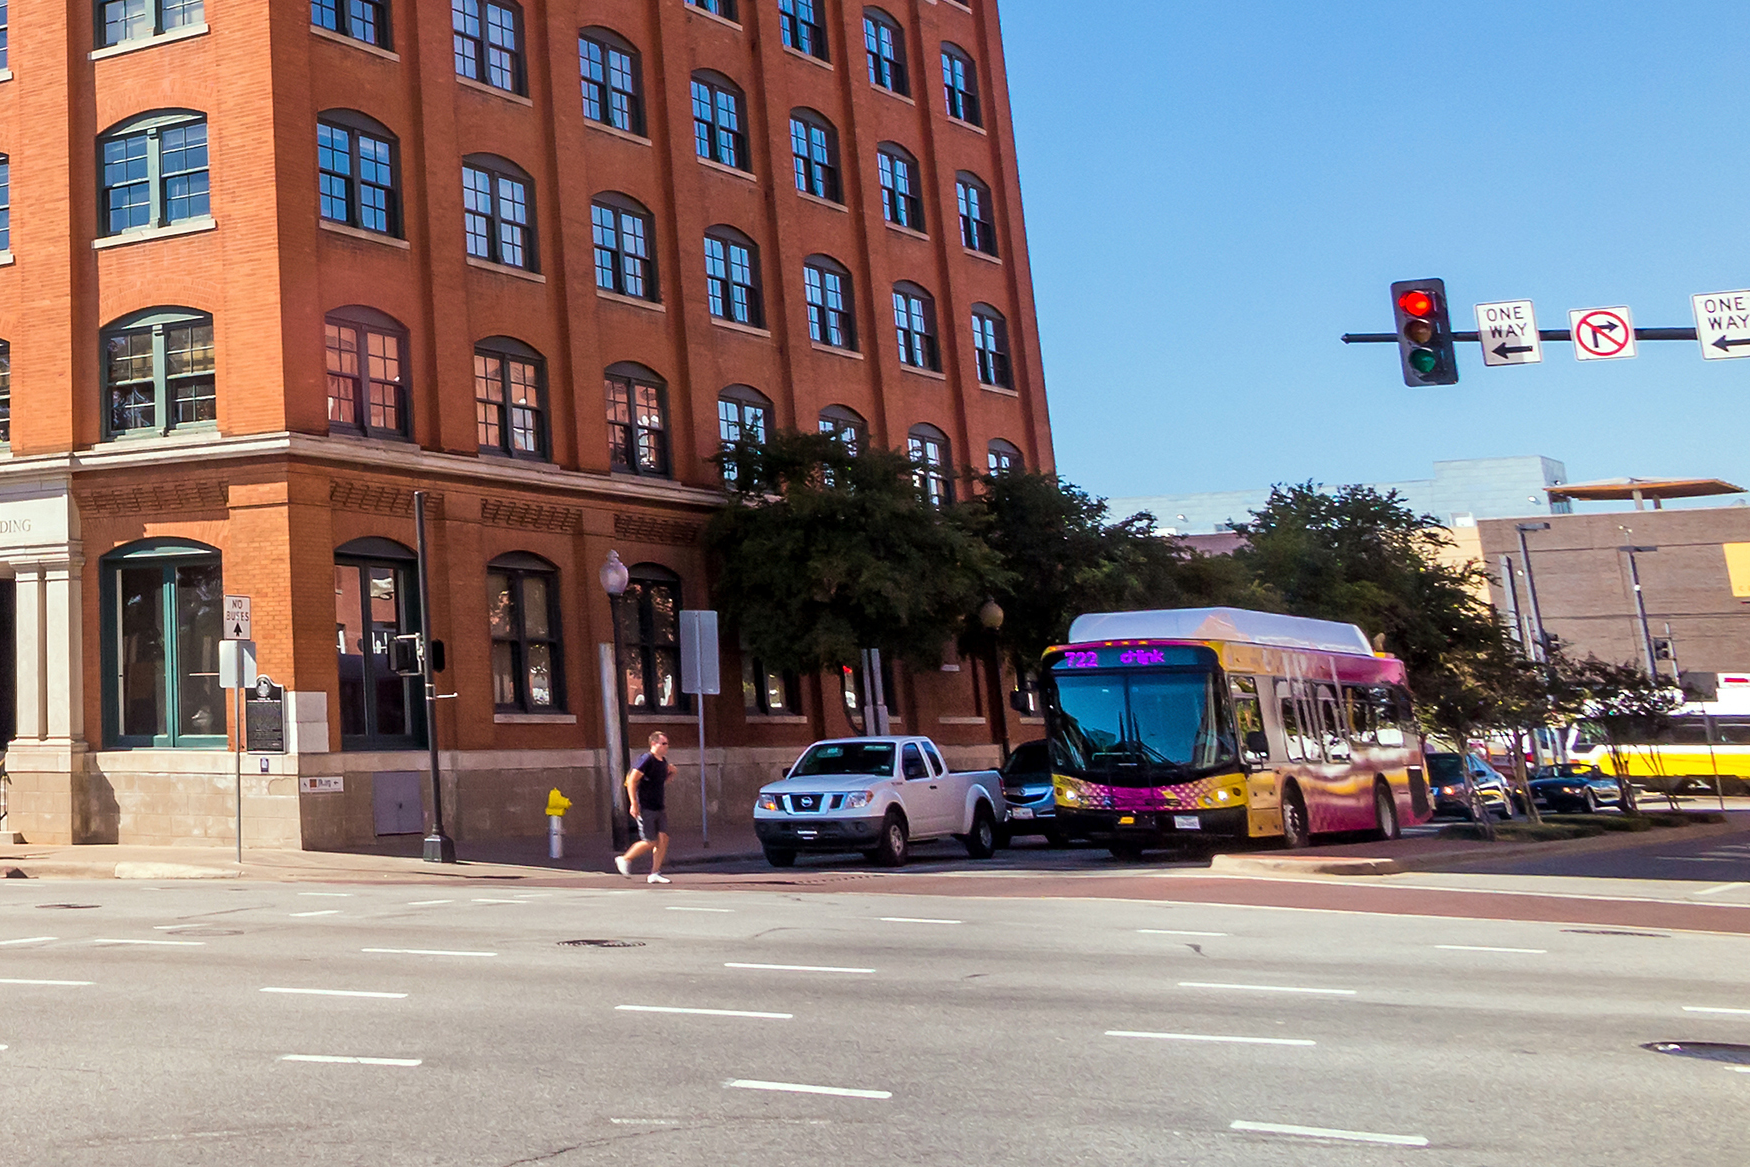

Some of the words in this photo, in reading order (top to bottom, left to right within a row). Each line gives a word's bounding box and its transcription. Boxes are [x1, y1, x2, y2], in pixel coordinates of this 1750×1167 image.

[1704, 296, 1747, 313] ONE
[1486, 305, 1524, 322] ONE
[1708, 314, 1750, 330] WAY
[1489, 323, 1527, 338] WAY
[231, 599, 243, 610] NO
[226, 610, 249, 622] BUSES
[1064, 651, 1098, 668] 722
